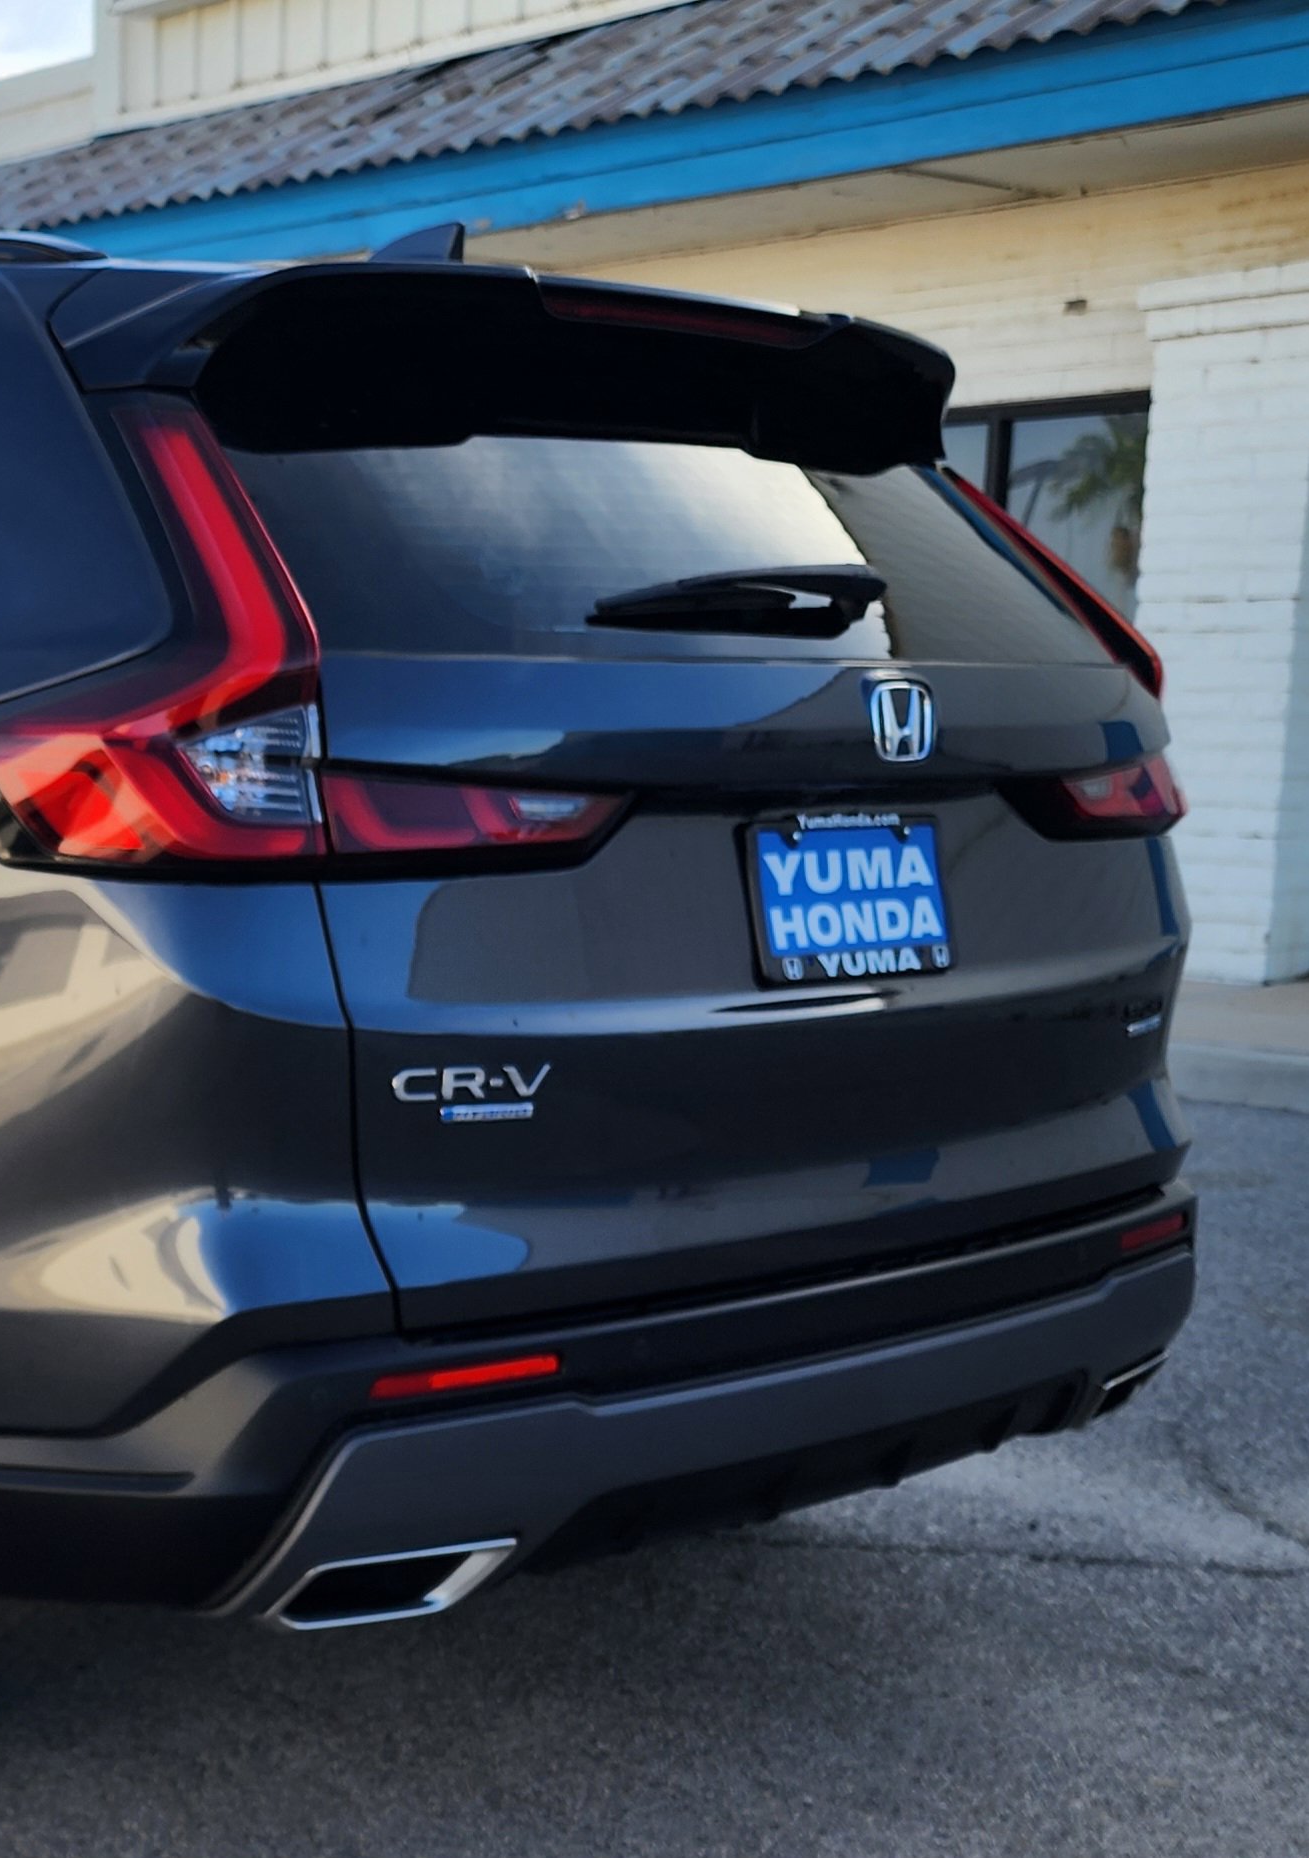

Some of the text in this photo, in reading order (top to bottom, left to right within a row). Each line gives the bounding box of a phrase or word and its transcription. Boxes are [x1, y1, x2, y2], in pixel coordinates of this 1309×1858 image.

[796, 813, 900, 830] YumaHonda.com
[764, 846, 935, 896] YUMA
[769, 896, 944, 950] HONDA
[817, 947, 922, 978] YUMA
[391, 1063, 551, 1101] CR-V
